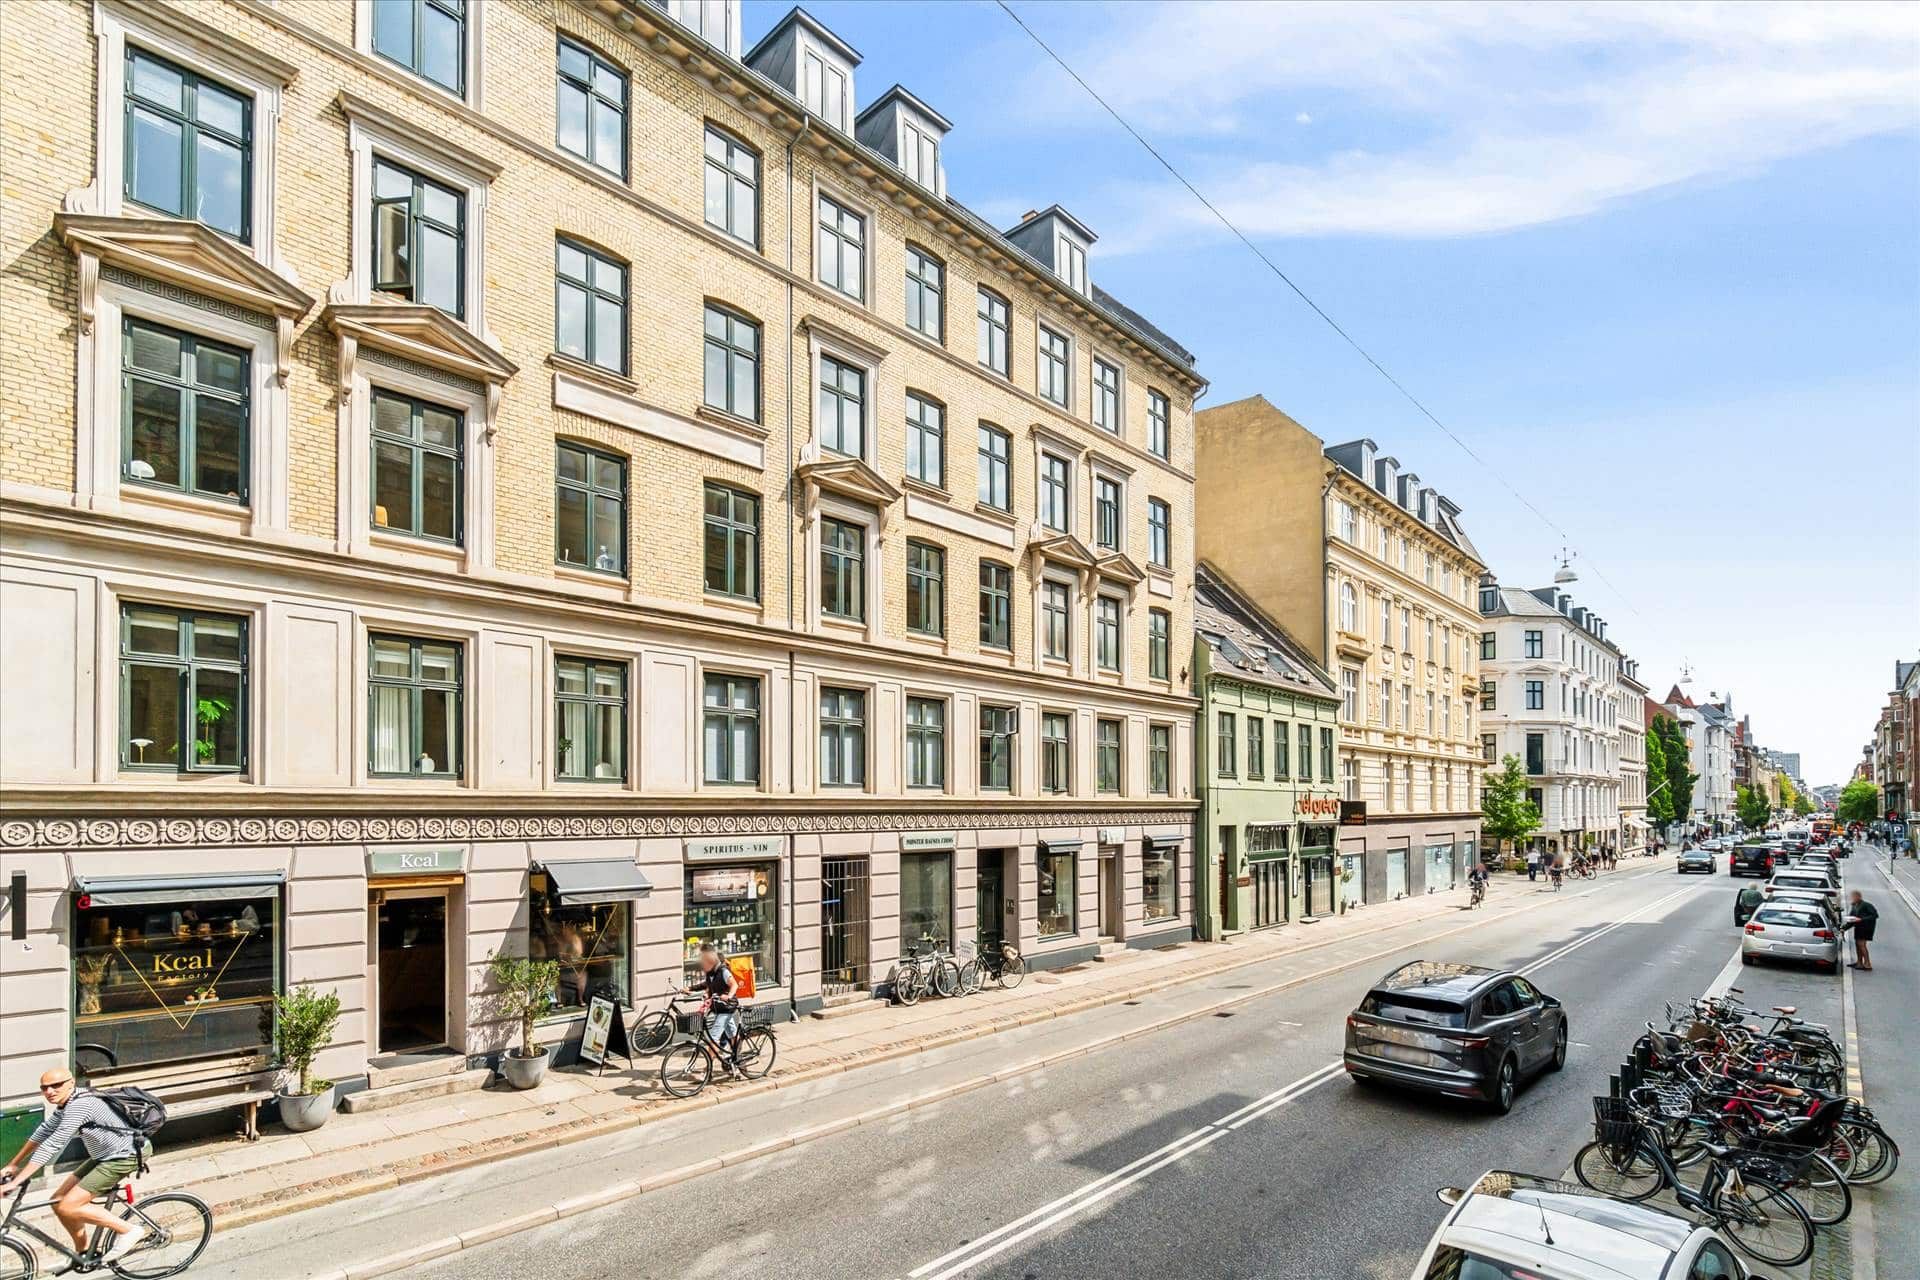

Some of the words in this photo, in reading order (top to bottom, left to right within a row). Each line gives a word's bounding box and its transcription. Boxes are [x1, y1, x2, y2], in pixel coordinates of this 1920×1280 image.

[703, 845, 744, 854] SPIRITUS
[400, 852, 439, 868] Kcal
[152, 948, 213, 973] Kcal
[158, 973, 209, 982] Factory
